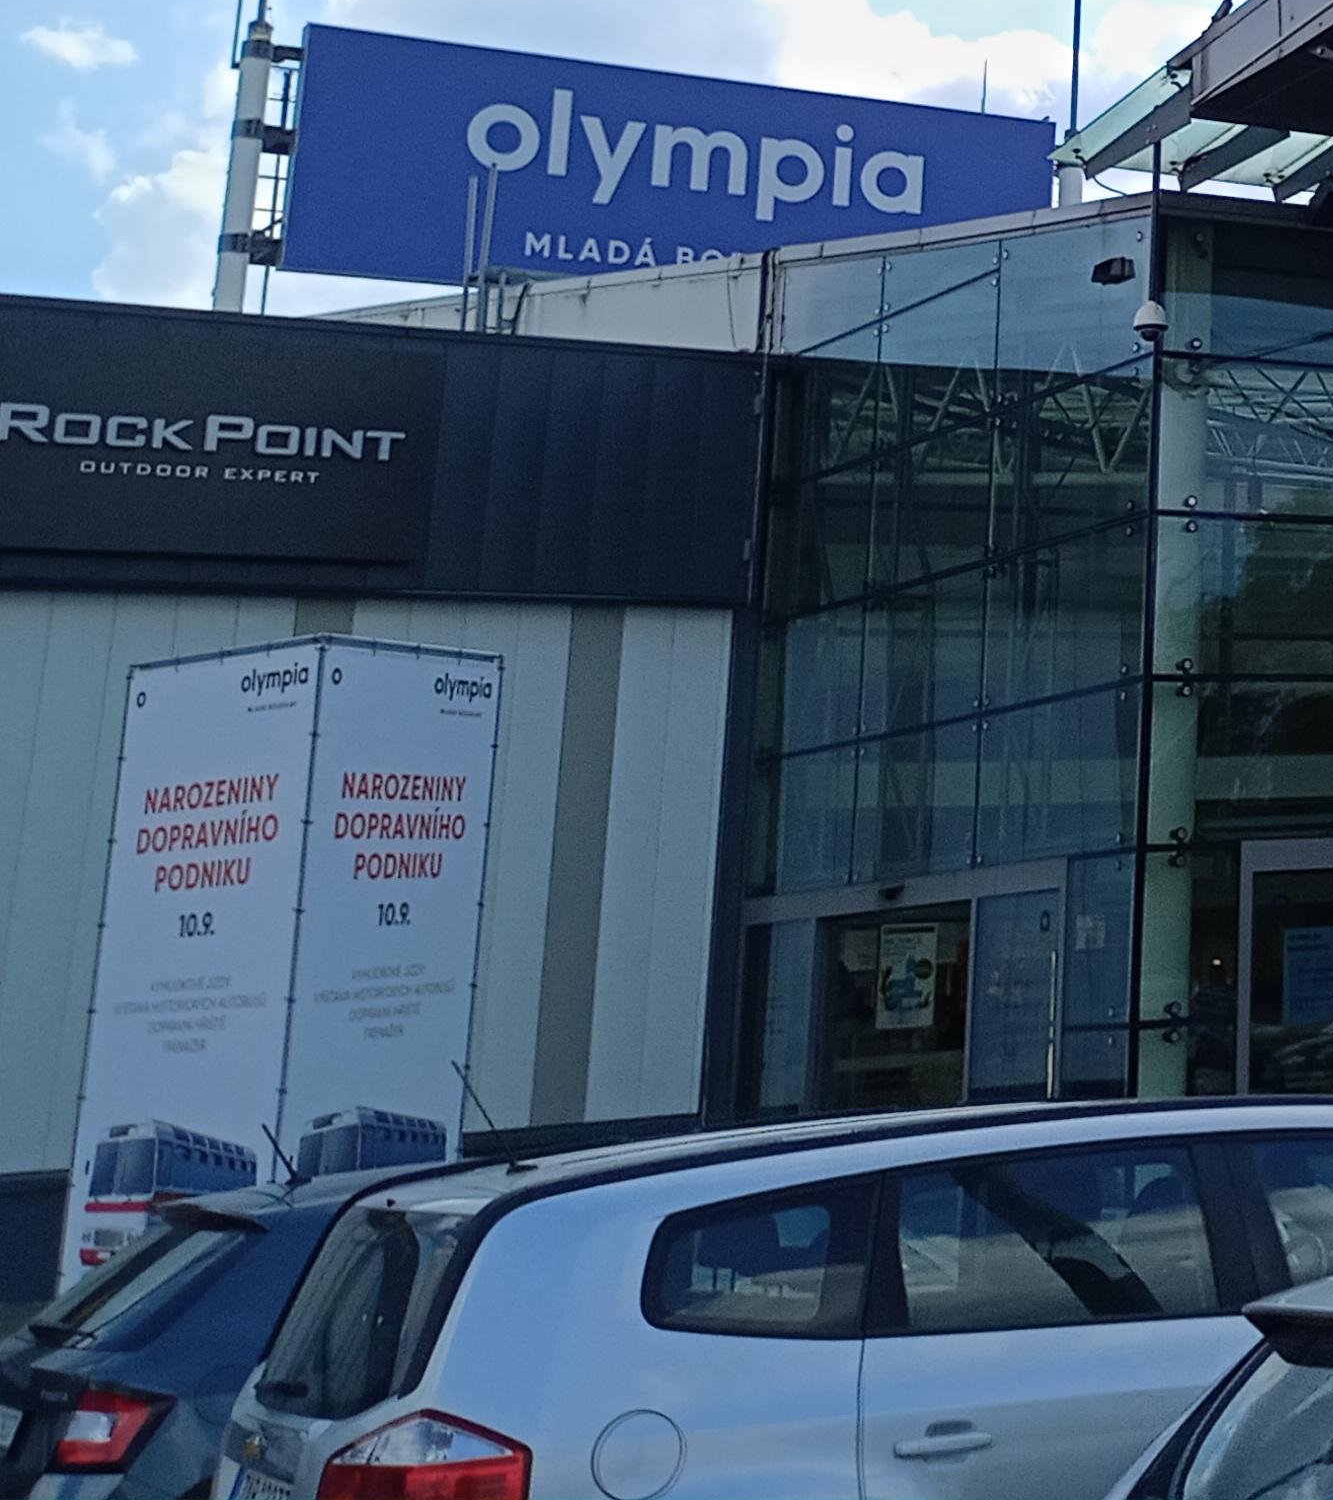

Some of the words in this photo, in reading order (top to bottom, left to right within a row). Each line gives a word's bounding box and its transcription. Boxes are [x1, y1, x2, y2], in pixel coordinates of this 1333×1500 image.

[467, 88, 925, 221] olympia
[524, 231, 657, 267] MLADÁ
[0, 402, 195, 451] ROCK
[203, 414, 407, 461] POINT
[80, 460, 209, 479] OUTDOOR
[224, 467, 321, 484] EXPERT
[240, 661, 310, 697] olympia
[433, 672, 493, 703] olympia
[143, 772, 280, 816] NAROZENINY
[341, 771, 467, 803] NAROZENINY
[135, 809, 280, 855] DOPRAVNÍHO
[334, 806, 467, 841] DOPRAVNÍHO
[153, 856, 252, 894] PODNIKU
[352, 852, 444, 881] PODNIKU
[178, 910, 217, 938] 10.9.
[377, 901, 412, 928] 10.9.
